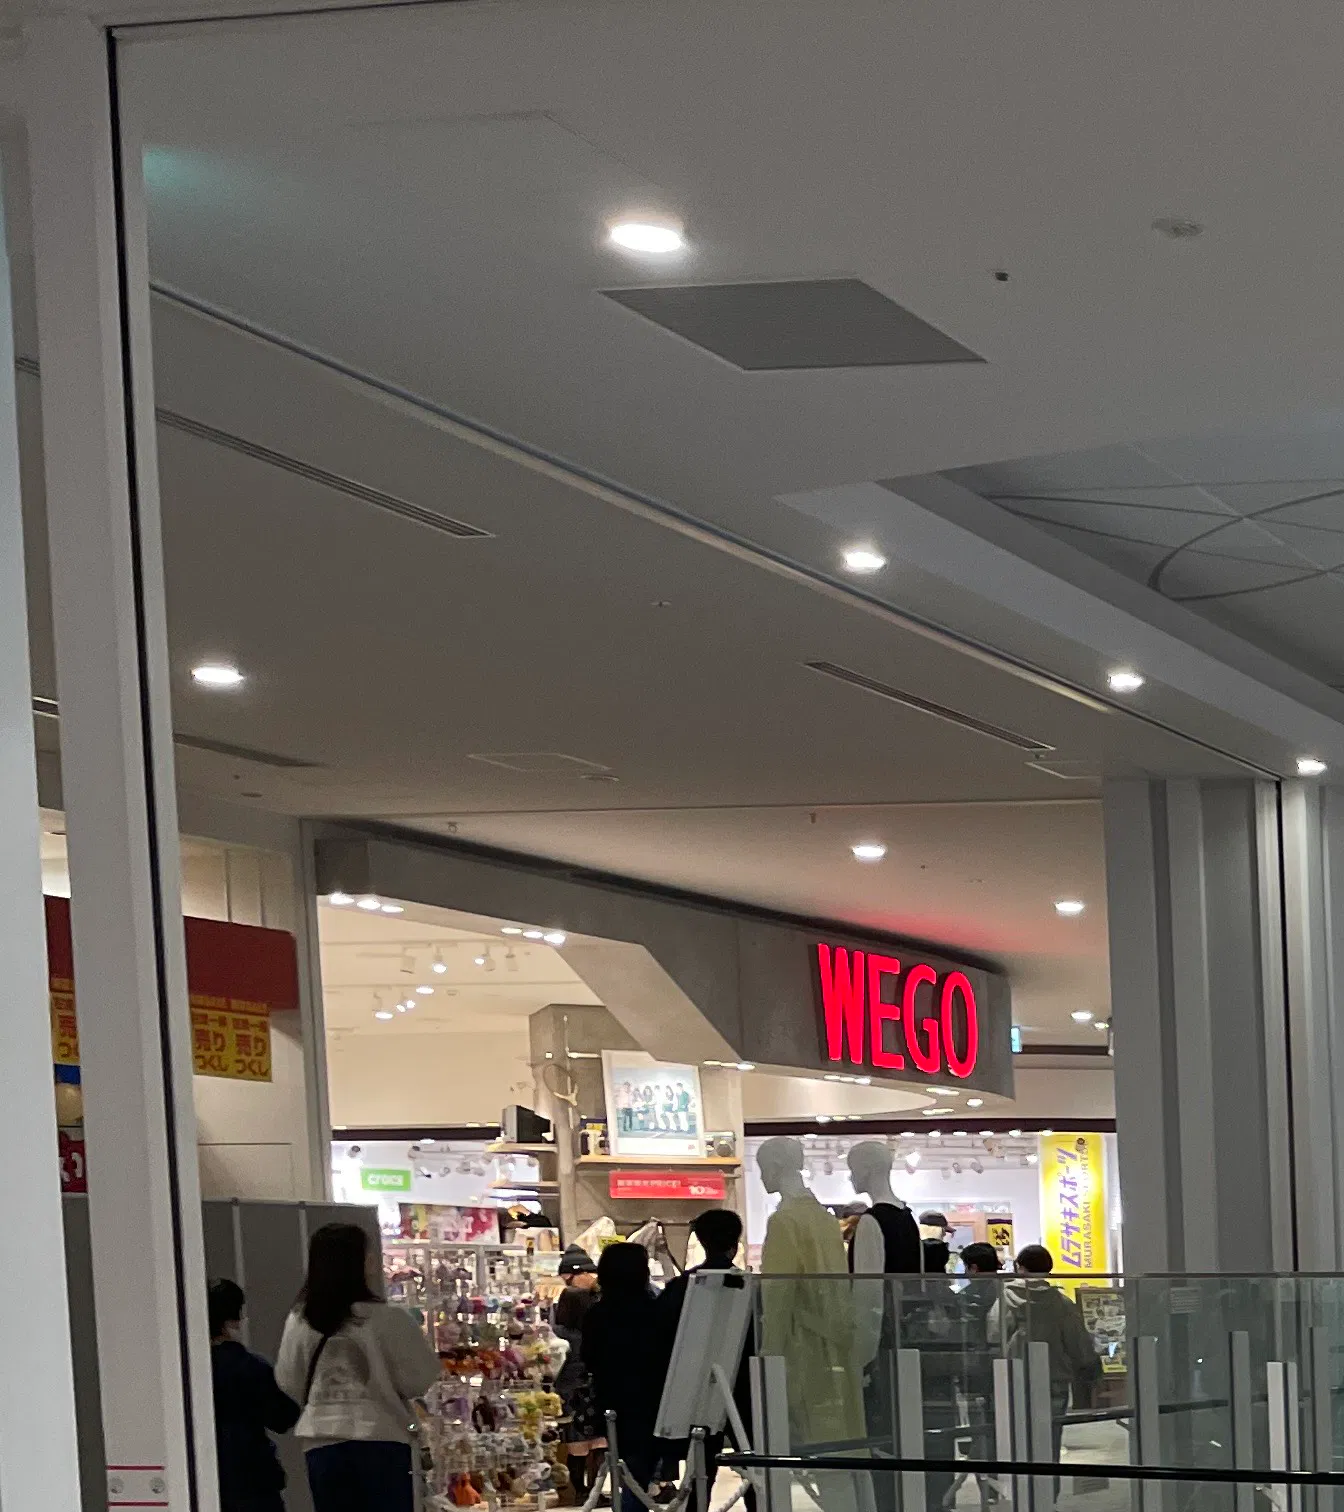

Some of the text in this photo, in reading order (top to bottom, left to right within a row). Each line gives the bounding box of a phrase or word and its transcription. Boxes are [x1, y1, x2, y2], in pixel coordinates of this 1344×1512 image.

[818, 943, 978, 1078] WEGO
[1056, 1148, 1082, 1268] ムラサキスポーツ
[1083, 1201, 1093, 1269] MURASAKI
